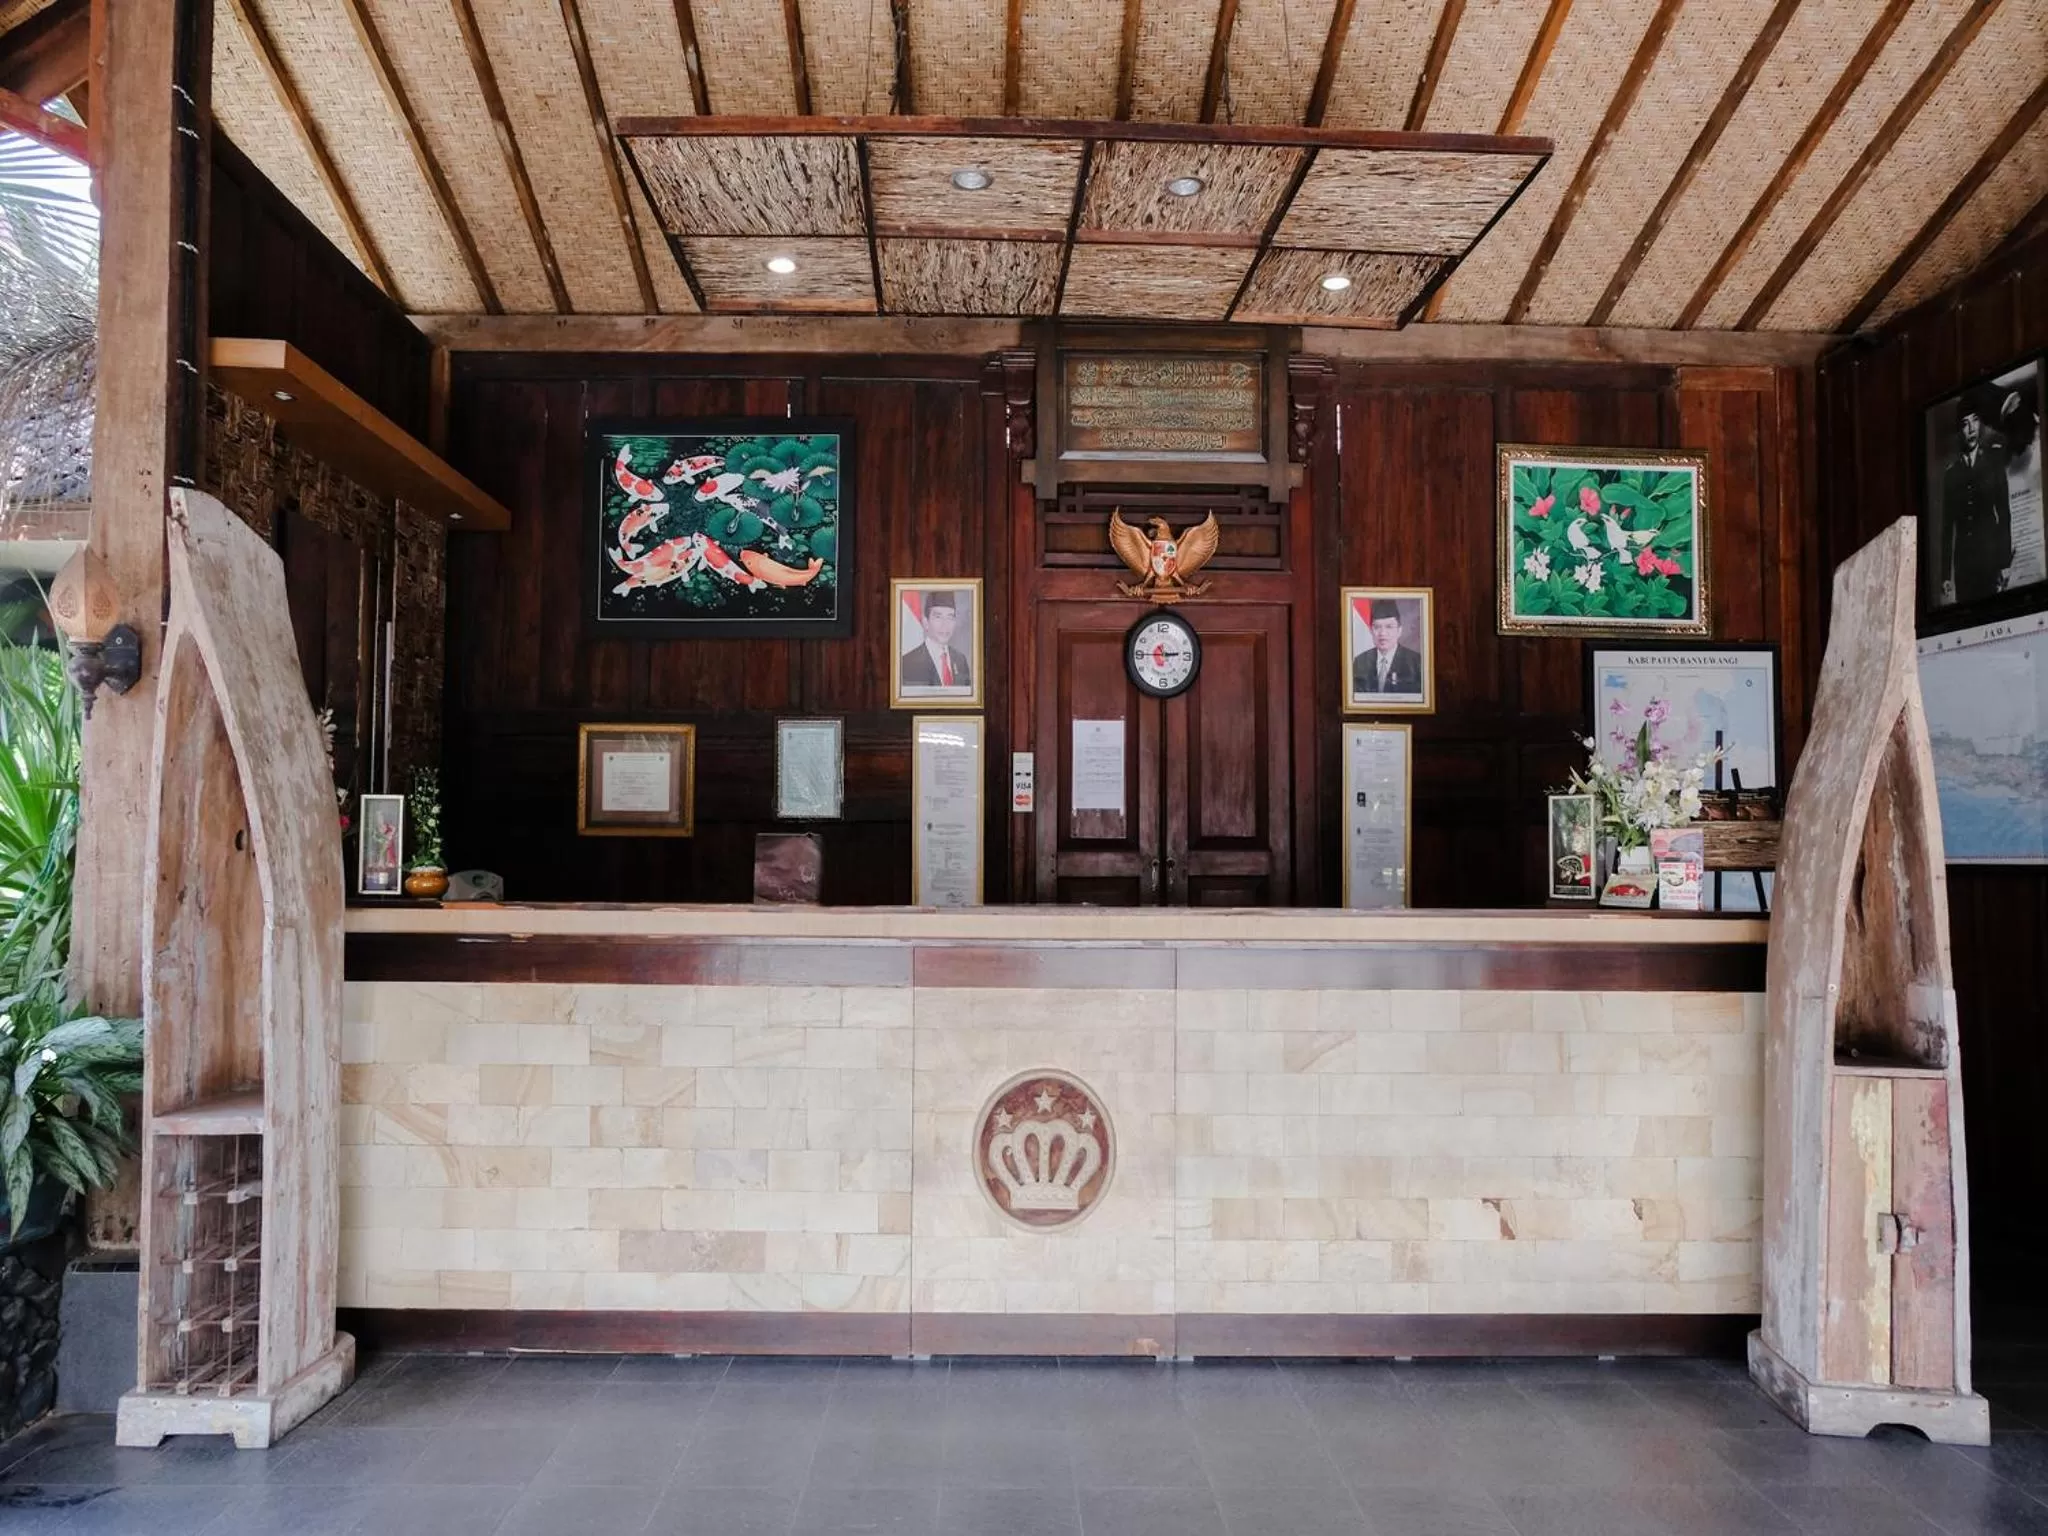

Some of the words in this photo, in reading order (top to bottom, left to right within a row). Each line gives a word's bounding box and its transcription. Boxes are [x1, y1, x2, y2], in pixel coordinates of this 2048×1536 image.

[1157, 623, 1170, 633] 12
[1182, 651, 1192, 662] 3
[1158, 678, 1168, 688] 6
